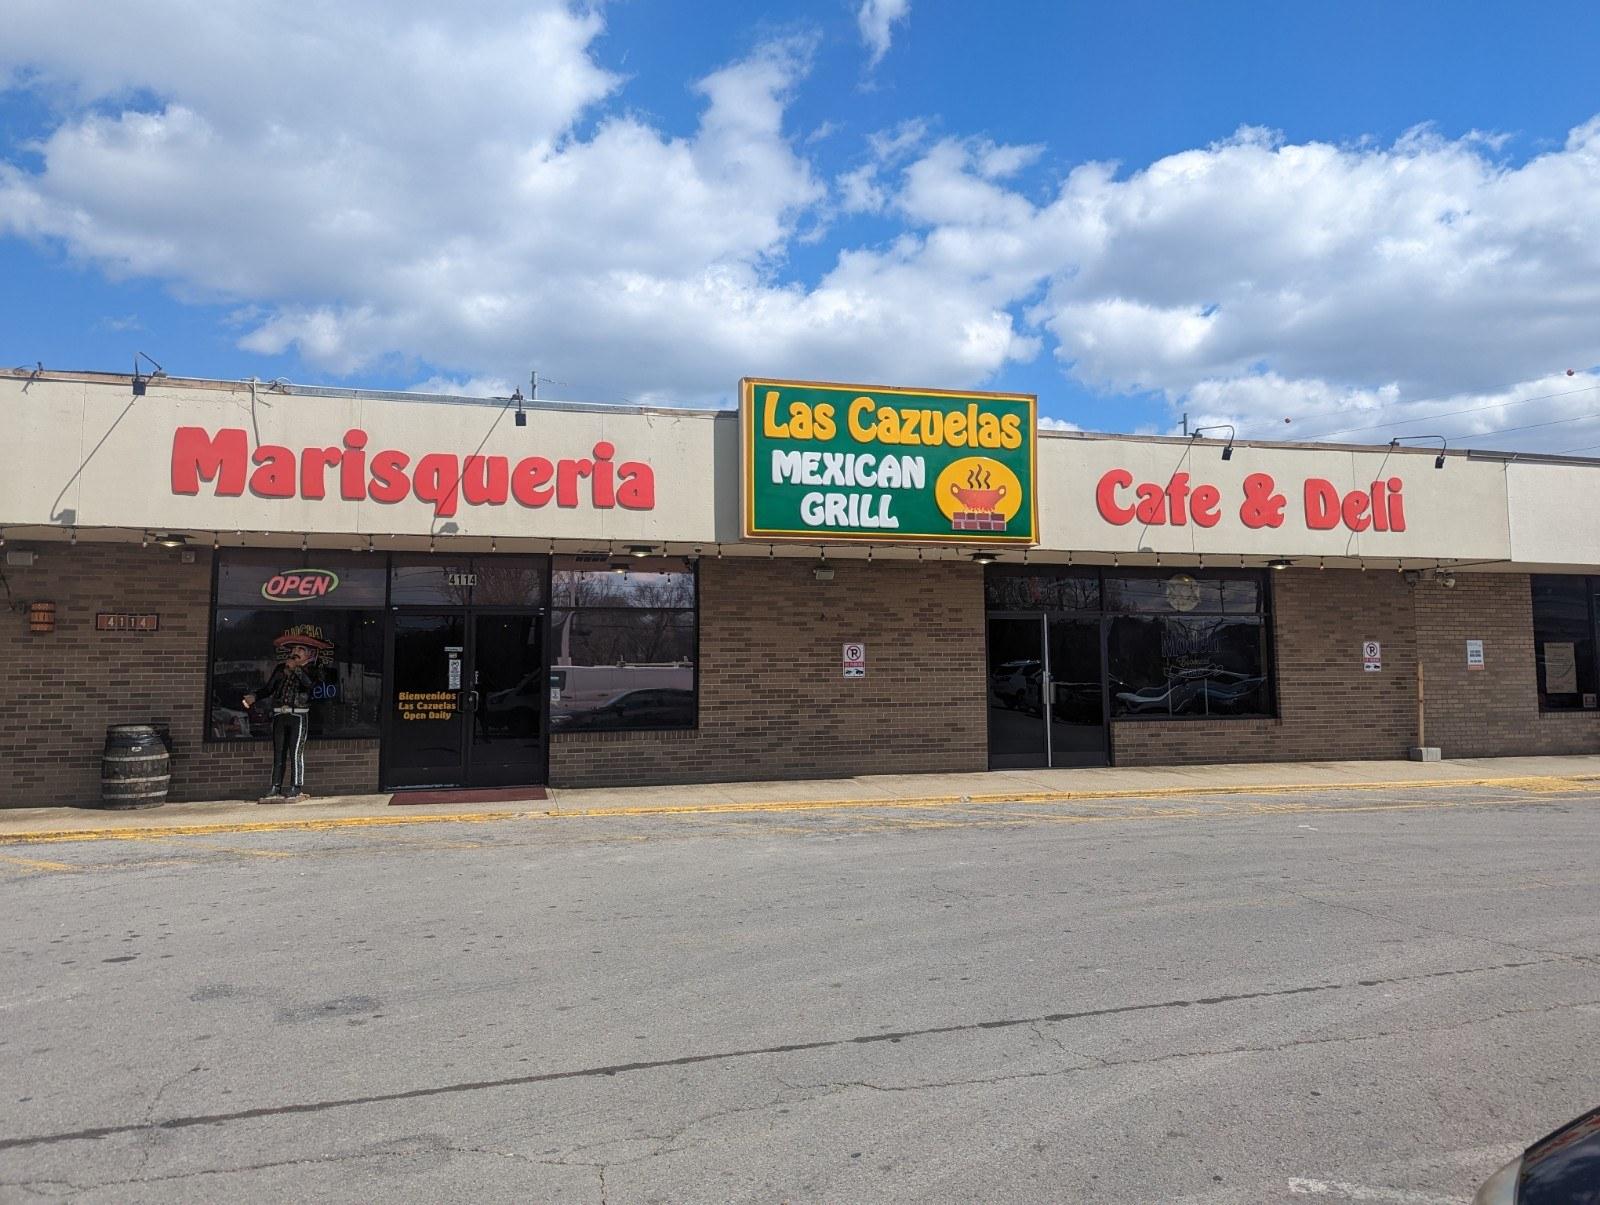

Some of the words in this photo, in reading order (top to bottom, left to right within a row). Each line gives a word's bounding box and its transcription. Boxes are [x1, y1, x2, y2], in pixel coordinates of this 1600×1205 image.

[764, 391, 836, 441] Las
[848, 396, 1022, 449] Cazuelas
[171, 427, 655, 518] Marisqueria
[772, 450, 926, 489] MEXICAN
[800, 492, 899, 528] GRILL
[1096, 469, 1221, 528] Cafe
[1240, 473, 1287, 529] &
[1304, 477, 1407, 532] Deli
[266, 575, 330, 595] OPEN
[449, 574, 477, 585] 4114
[107, 616, 146, 627] 4114
[398, 702, 414, 710] Las
[416, 702, 457, 710] Cazuelas
[399, 691, 457, 701] Bienvenidos
[403, 711, 426, 720] Open
[428, 711, 451, 720] Daily
